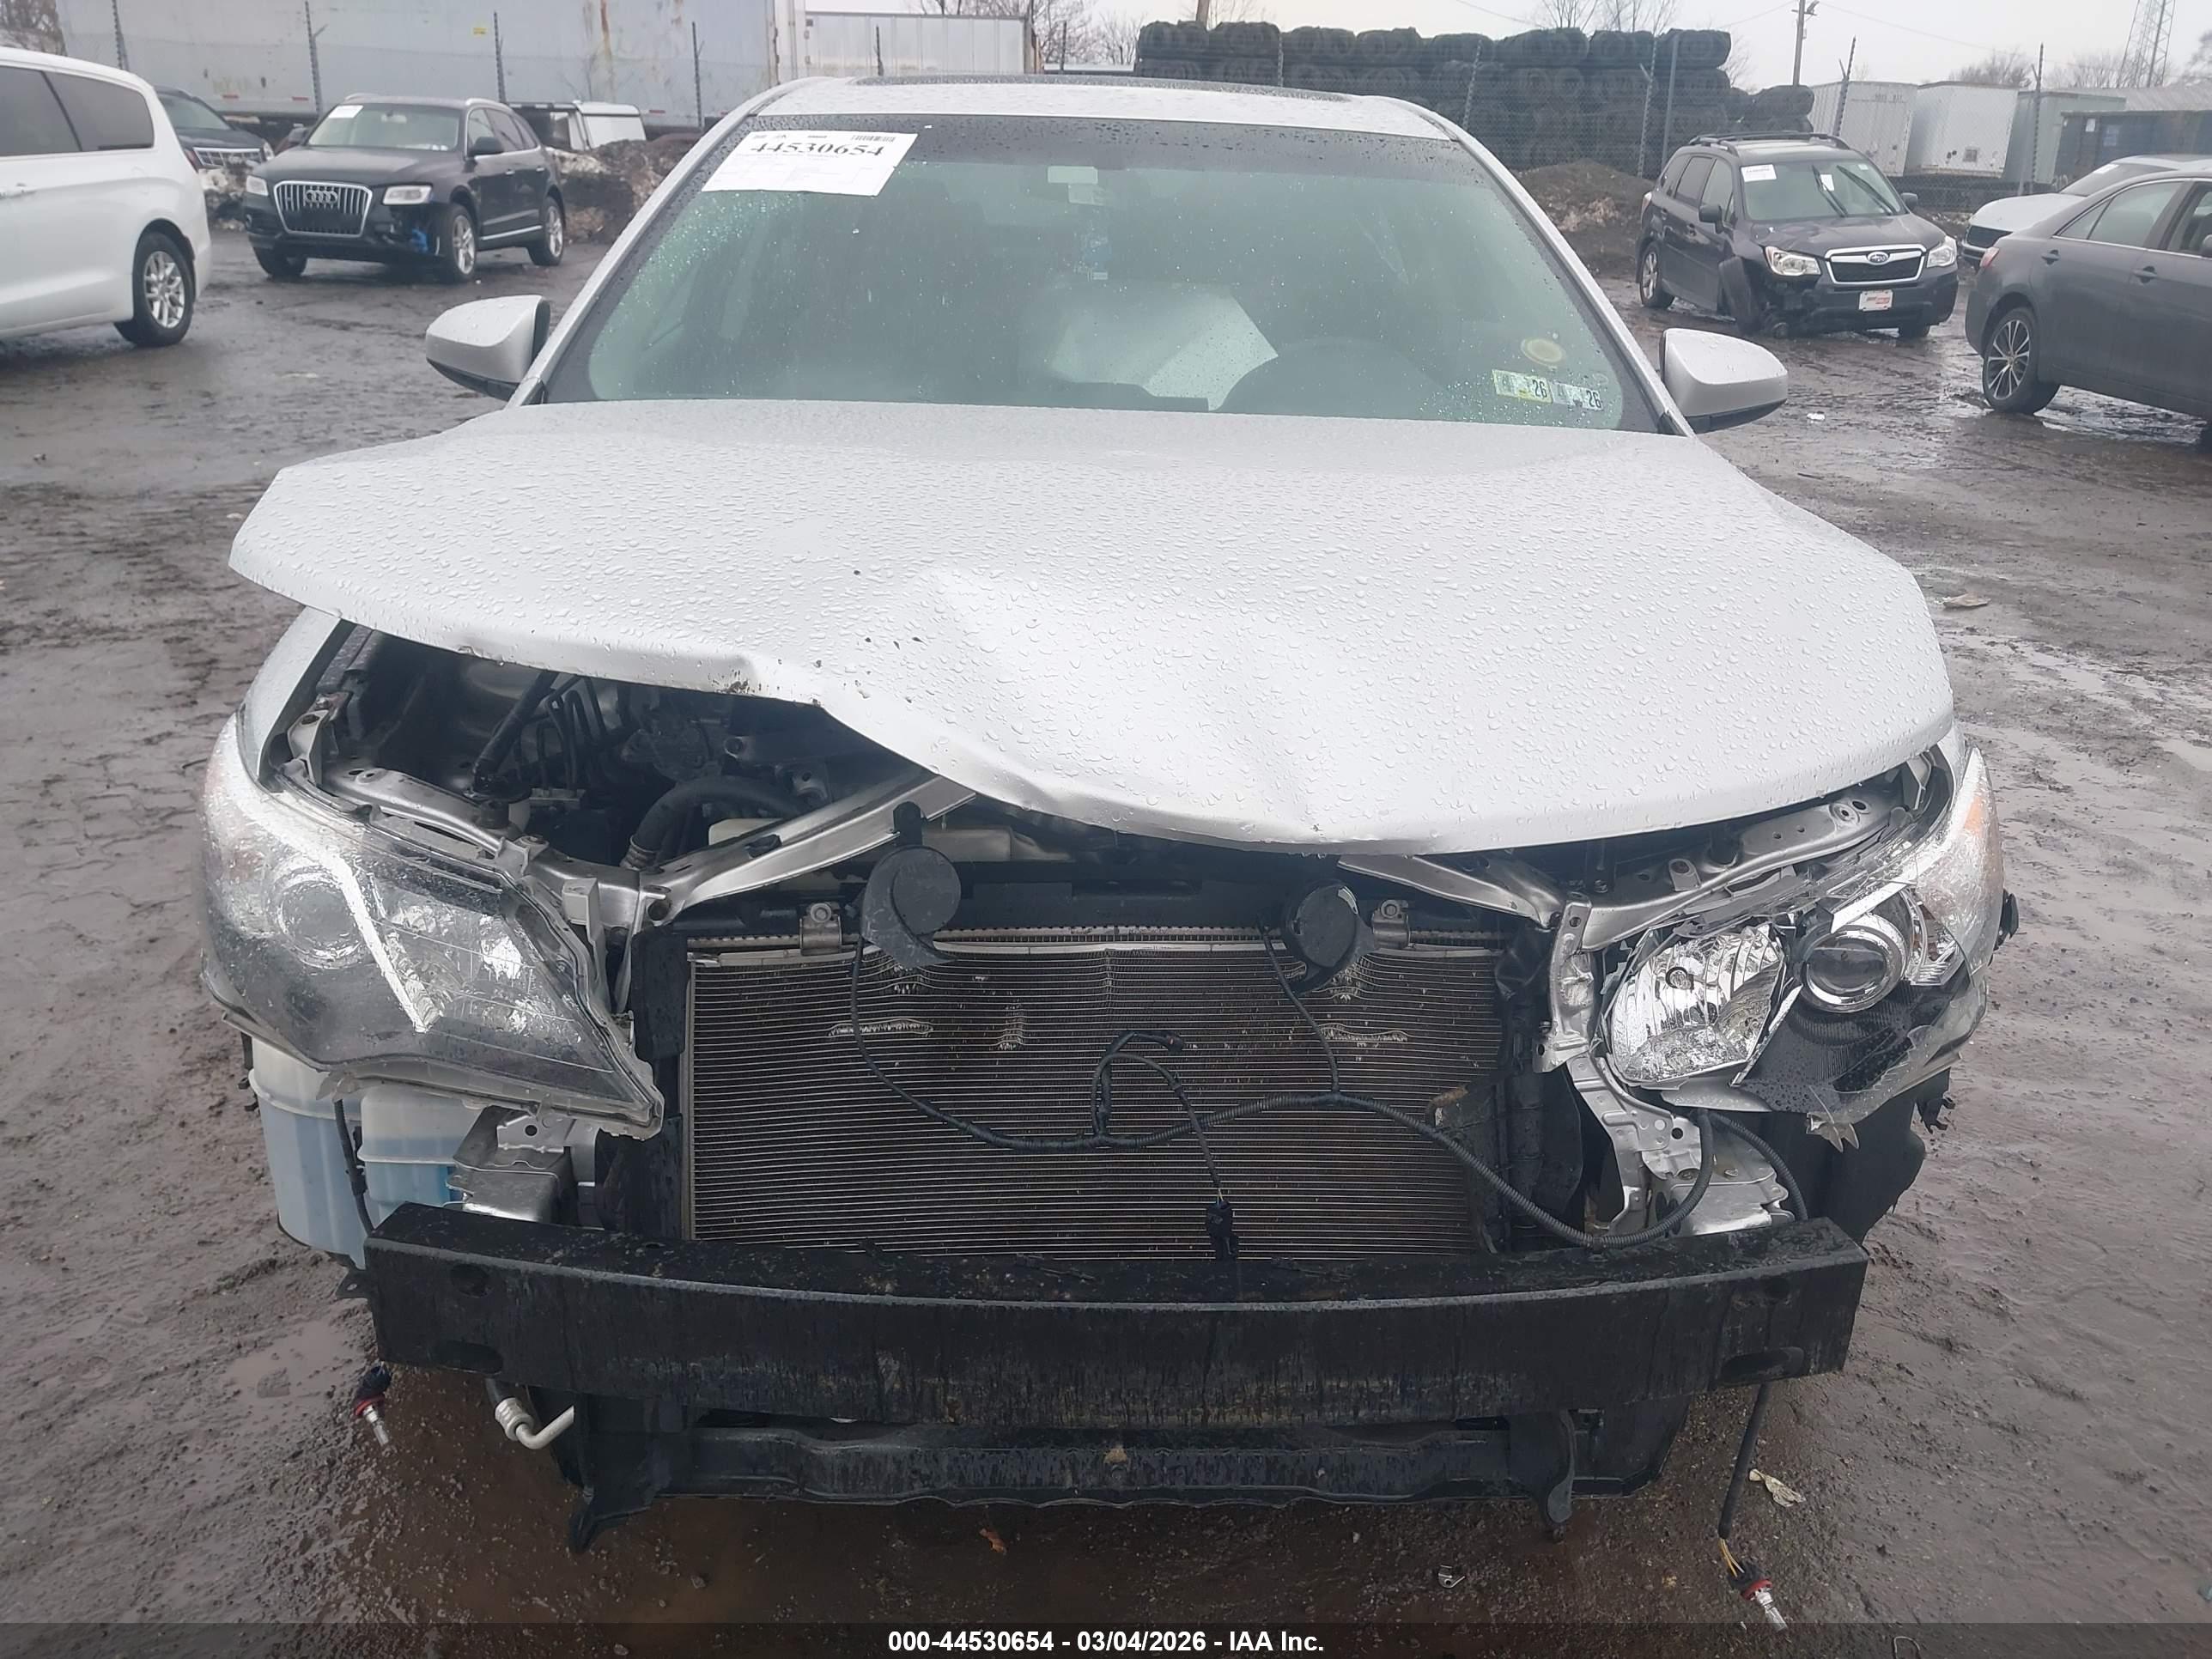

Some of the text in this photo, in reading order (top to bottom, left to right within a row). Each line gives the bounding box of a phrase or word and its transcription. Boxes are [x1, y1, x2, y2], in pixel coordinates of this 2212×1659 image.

[750, 142, 884, 156] 44530654
[1532, 379, 1547, 398] 26
[1586, 390, 1602, 409] 26
